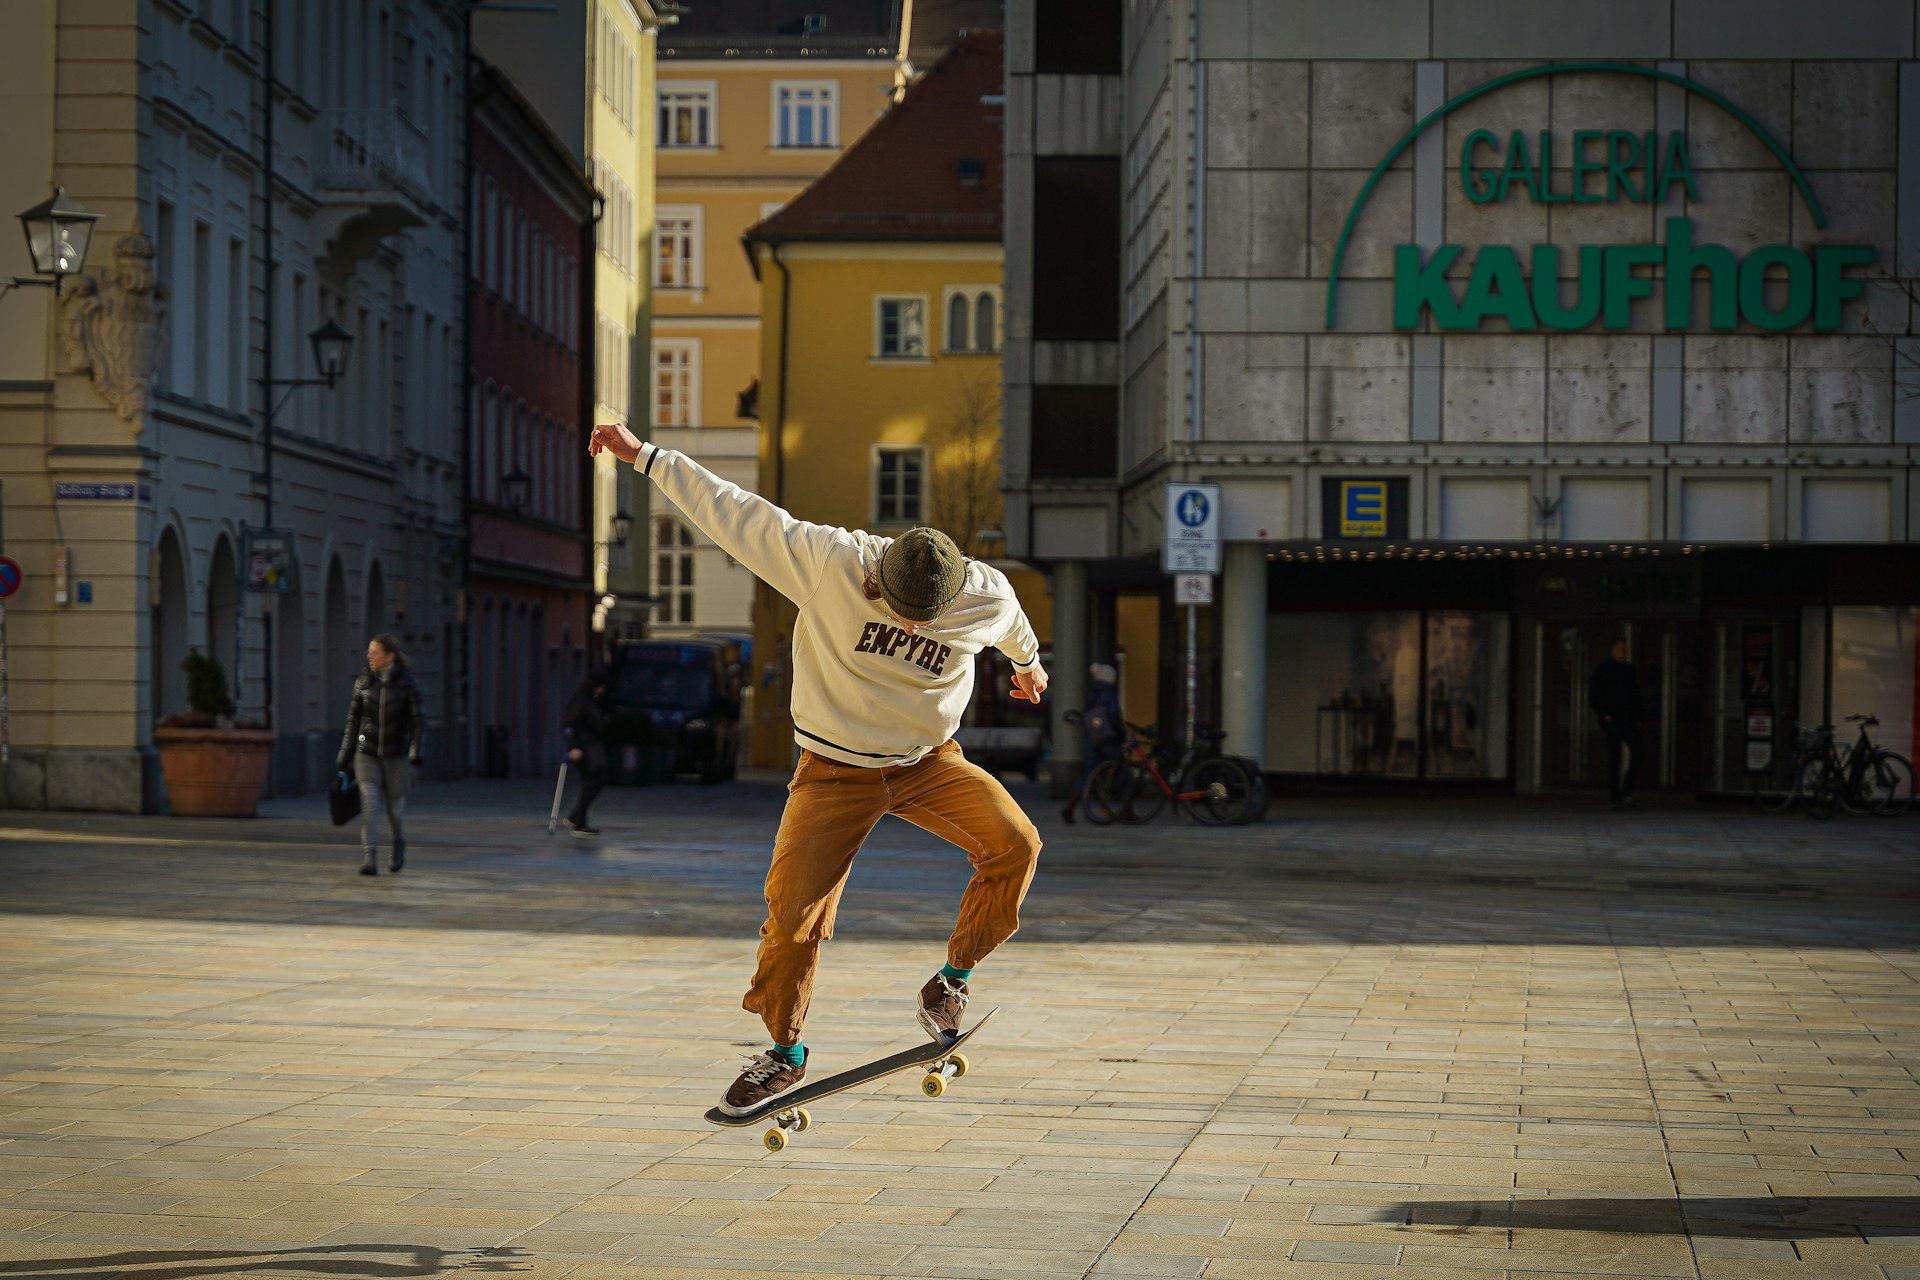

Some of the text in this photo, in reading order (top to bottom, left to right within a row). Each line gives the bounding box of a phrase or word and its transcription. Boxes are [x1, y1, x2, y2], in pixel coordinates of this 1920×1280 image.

[1460, 128, 1698, 204] GALERIA
[1346, 486, 1382, 521] E
[854, 621, 952, 677] EMPYRE
